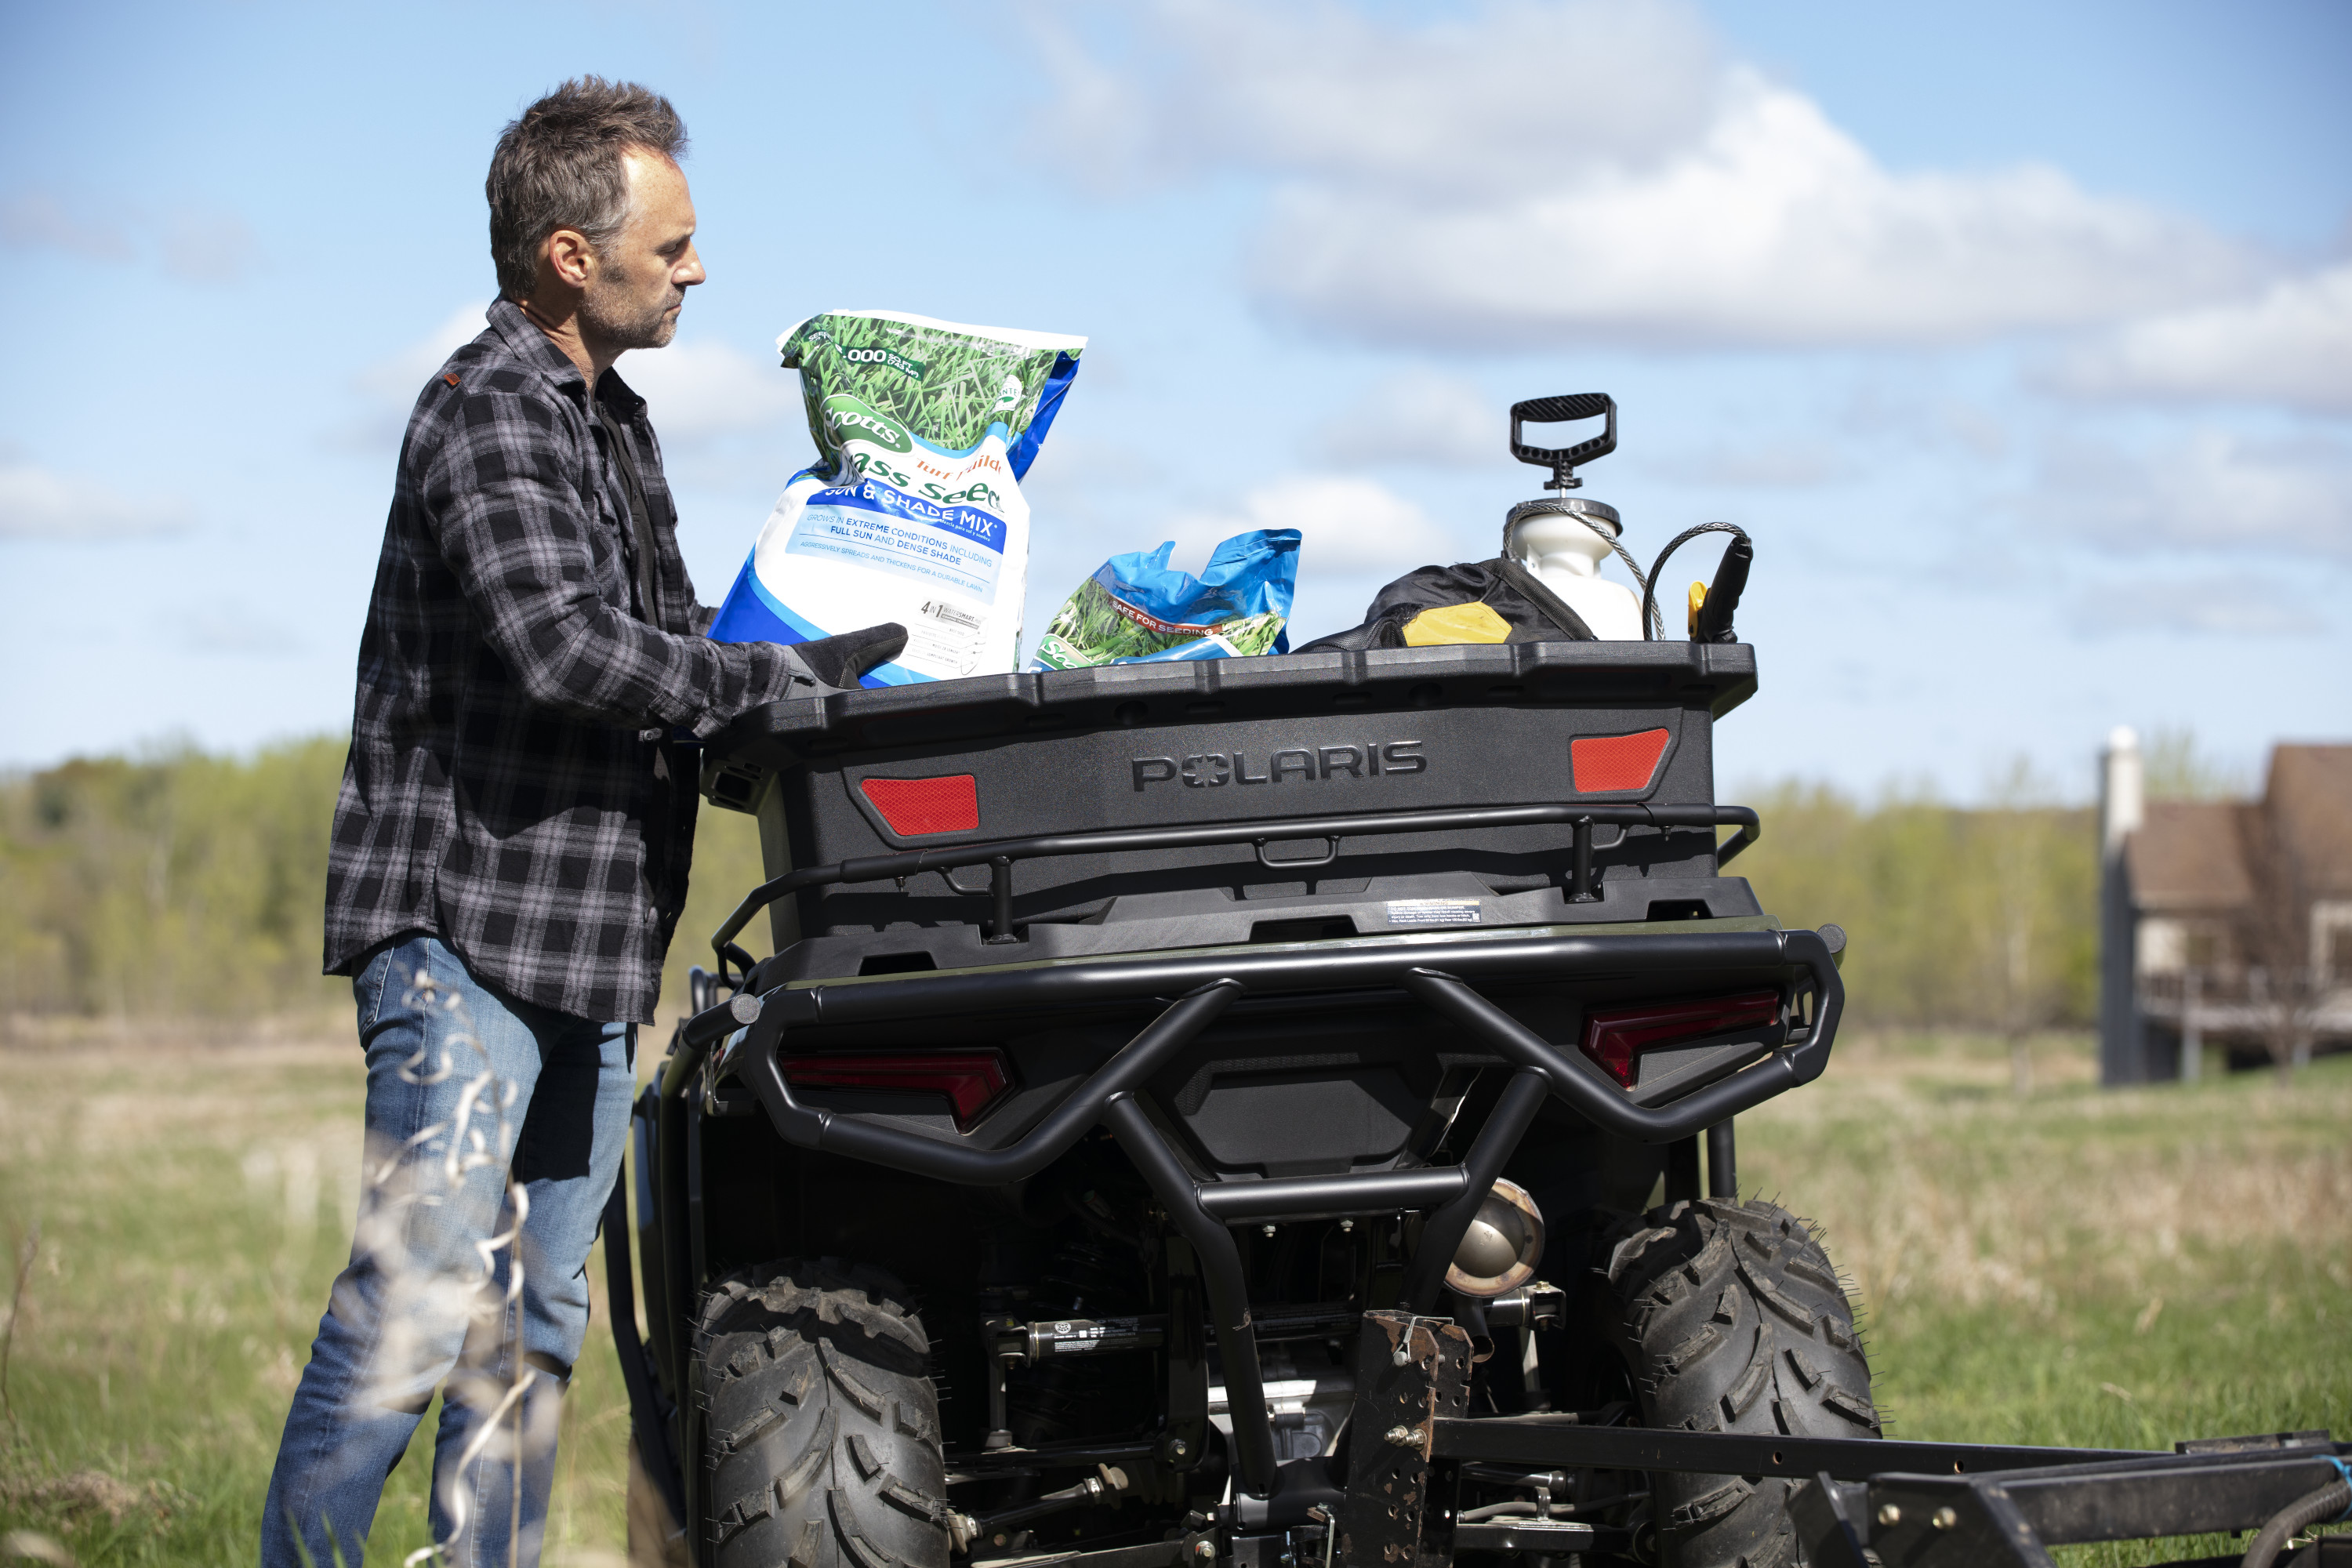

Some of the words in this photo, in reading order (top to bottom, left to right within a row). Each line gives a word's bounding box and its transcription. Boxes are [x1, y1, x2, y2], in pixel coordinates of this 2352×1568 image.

[916, 457, 954, 481] Turf
[862, 484, 876, 500] &
[881, 489, 954, 521] SHADE
[959, 510, 994, 537] MIX
[807, 514, 836, 523] GROWS
[846, 517, 890, 533] EXTREME
[891, 528, 948, 550] CONDITIONS
[949, 544, 993, 568] INCLUDING
[830, 525, 851, 535] FULL
[853, 529, 873, 540] SUN
[874, 535, 895, 546] AND
[897, 539, 929, 555] DENSE
[930, 549, 962, 565] SHADE
[800, 541, 840, 553] AGGRESSIVELY
[840, 547, 869, 559] SPREADS
[870, 554, 884, 563] AND
[886, 557, 916, 571] THICKENS
[916, 566, 931, 575] FOR
[937, 572, 966, 586] DURABLE
[966, 582, 983, 593] LAWN
[920, 601, 931, 614] 4
[929, 605, 937, 614] IN
[935, 604, 944, 618] 1
[1112, 600, 1136, 619] SAFE
[1136, 614, 1157, 629] FOR
[1157, 624, 1214, 636] SEEDING
[1131, 741, 1428, 792] POLARIS
